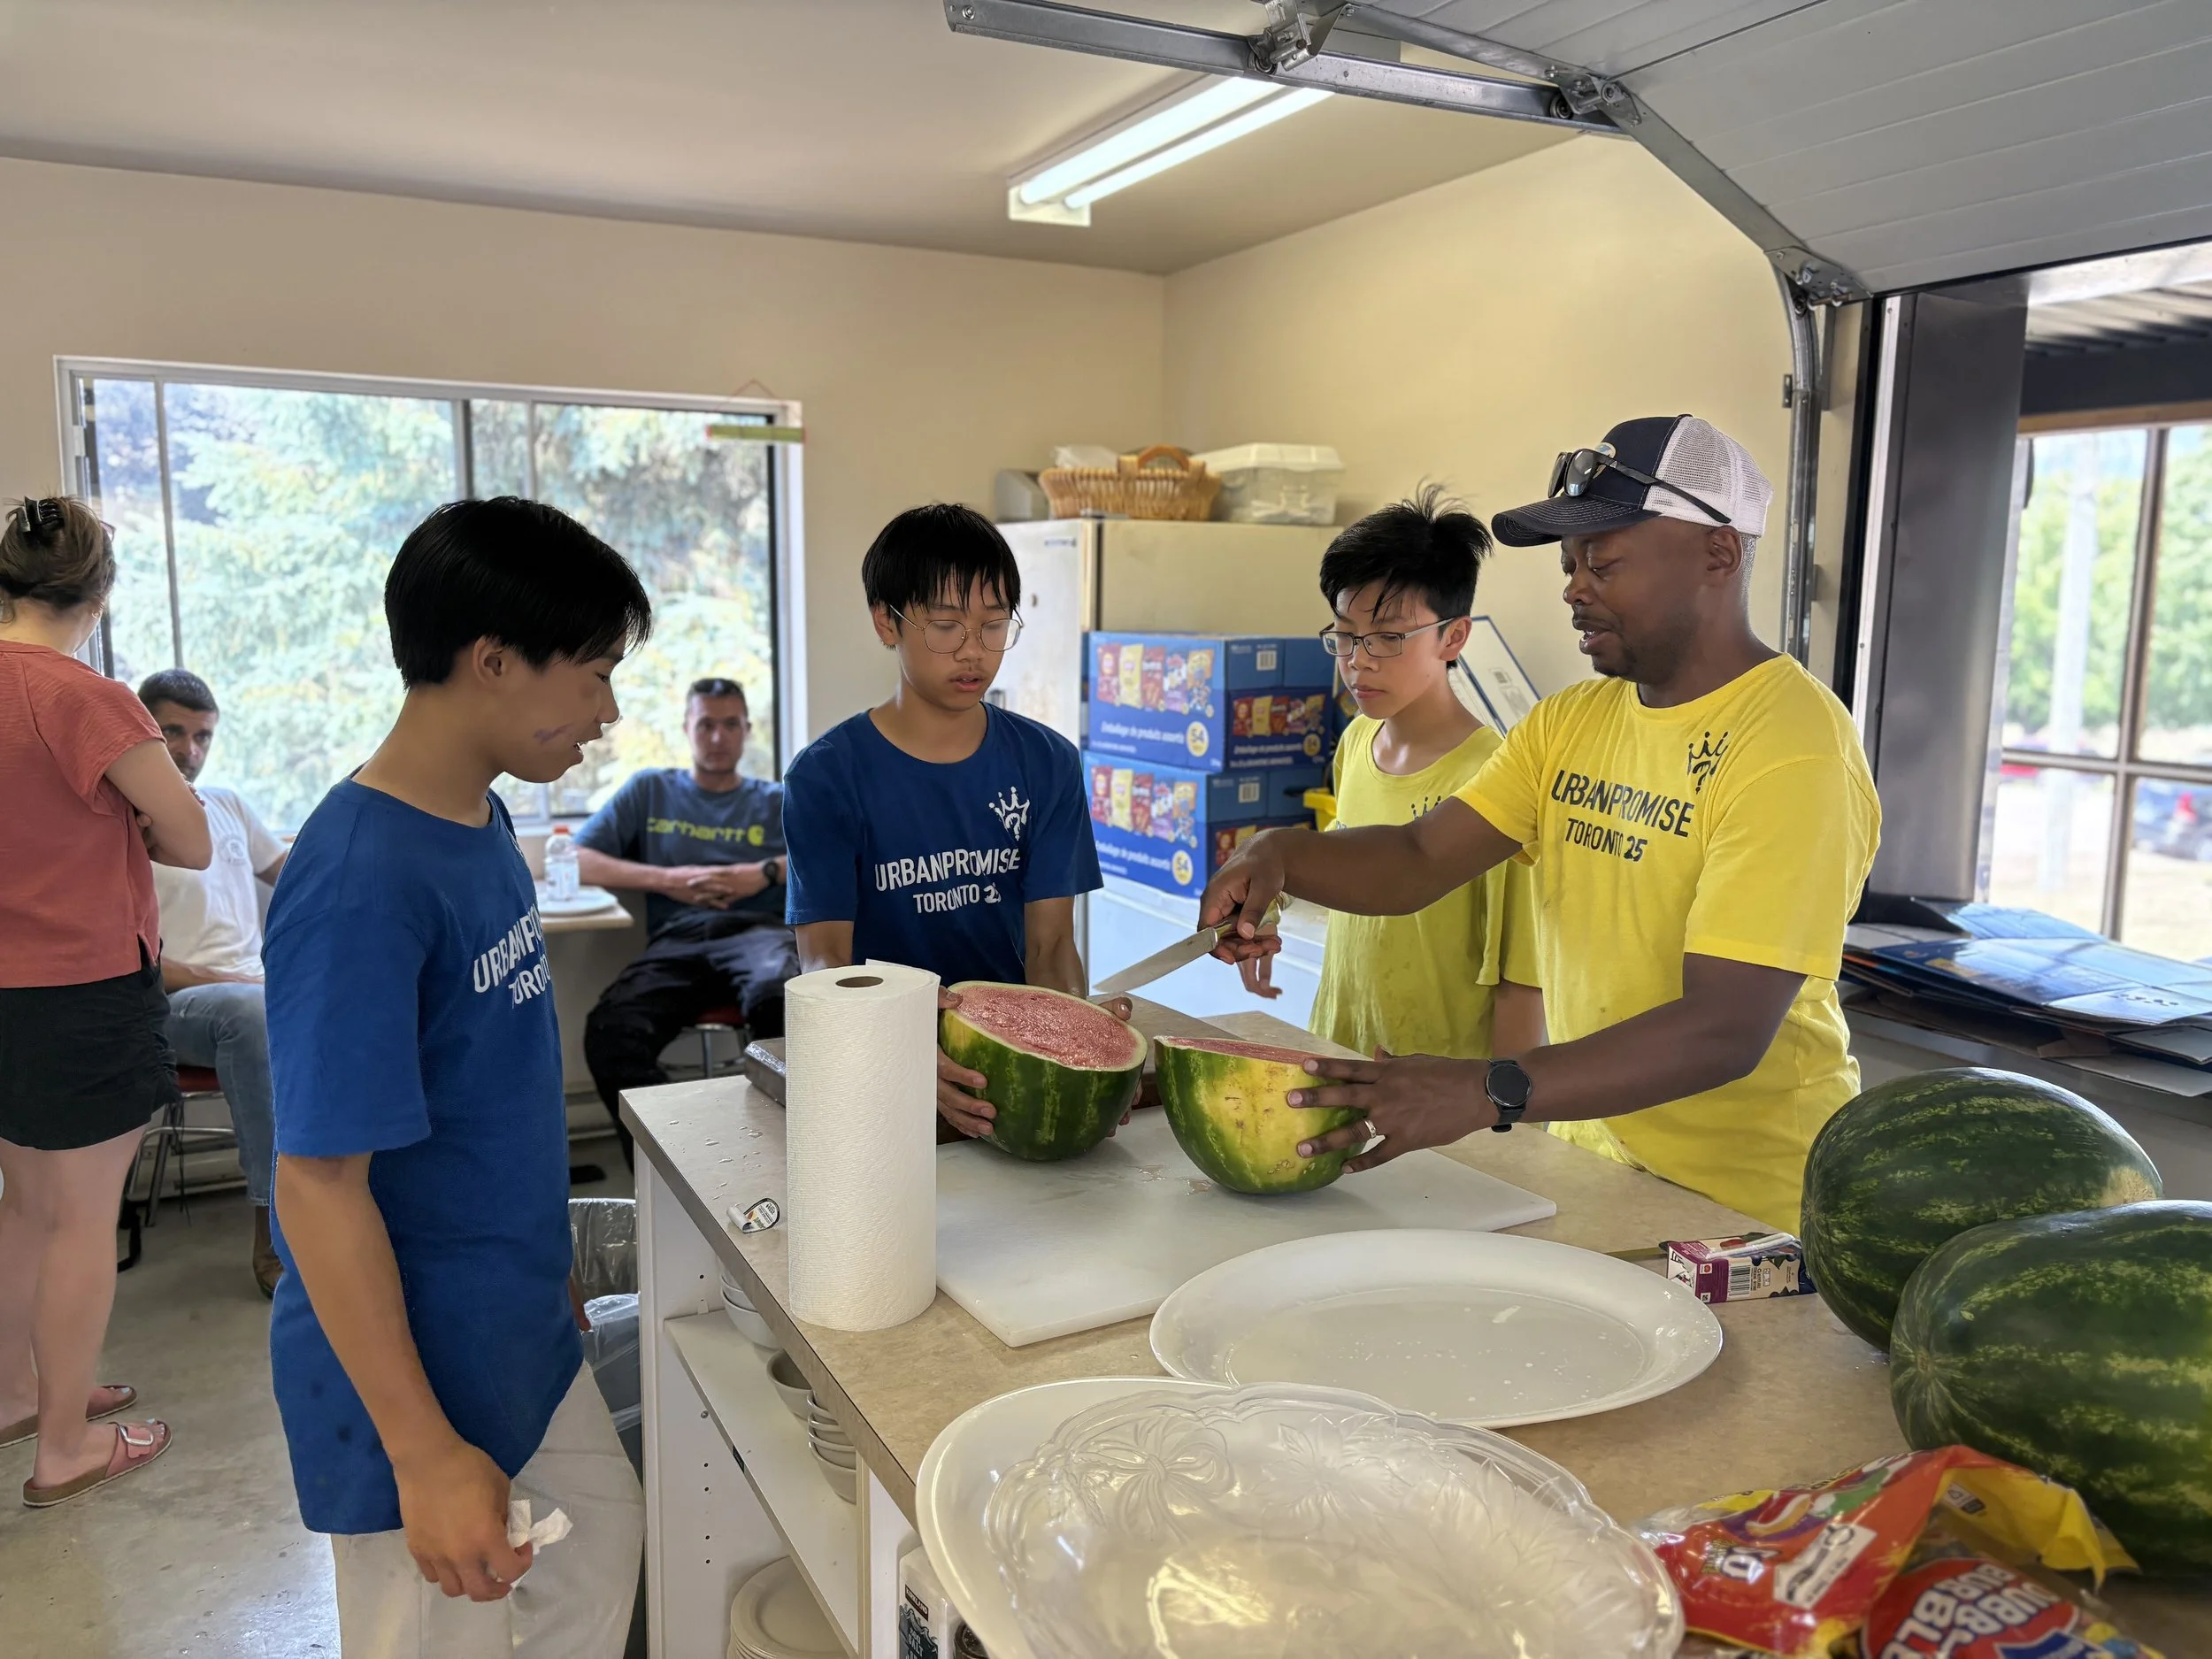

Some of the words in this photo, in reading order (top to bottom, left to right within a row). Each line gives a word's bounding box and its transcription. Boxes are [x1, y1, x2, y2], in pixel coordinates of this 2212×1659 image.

[1190, 727, 1205, 743] 54
[1551, 769, 1694, 838] URBANPROMISE
[1564, 818, 1624, 858] TORONTO
[1624, 835, 1647, 862] 25
[874, 848, 1021, 892] URBANPROMISE
[912, 883, 980, 913] TORONTO
